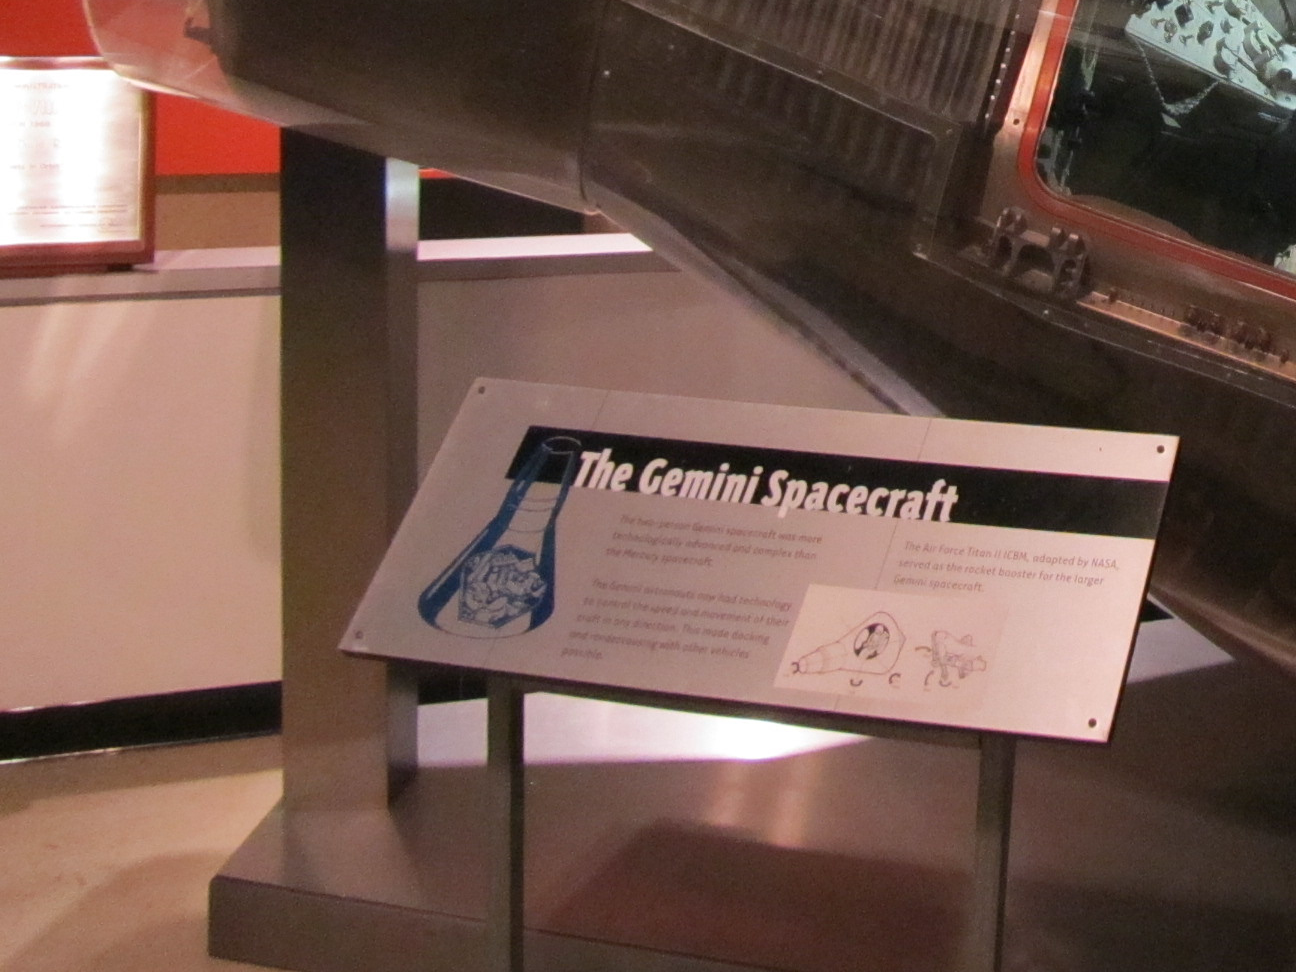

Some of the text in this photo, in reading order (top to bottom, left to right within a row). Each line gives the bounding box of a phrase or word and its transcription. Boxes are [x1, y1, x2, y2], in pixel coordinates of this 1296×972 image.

[574, 447, 960, 522] The Gemini Spacecraft
[692, 522, 724, 533] Gemini
[727, 528, 776, 540] spacecraft
[778, 533, 796, 541] was
[798, 535, 822, 544] more
[612, 532, 817, 559] technologically advanced and complex than
[905, 540, 921, 552] The
[922, 542, 937, 554] Air
[938, 543, 965, 556] Force
[968, 546, 992, 558] Titan
[1003, 550, 1029, 563] ICBM,
[1032, 554, 1075, 566] adapted
[1076, 556, 1089, 568] by
[1091, 558, 1120, 571] NASA,
[605, 548, 623, 557] the
[623, 549, 658, 564] Mercury
[893, 573, 985, 593] Gemini spacecraft.
[898, 560, 931, 570] served
[946, 562, 963, 572] the
[964, 565, 996, 576] rocket
[998, 567, 1036, 579] booster
[1038, 570, 1053, 581] for
[1055, 572, 1072, 582] the
[1074, 574, 1104, 587] larger
[717, 593, 738, 604] had
[739, 595, 793, 612] technology
[700, 611, 752, 623] movement
[753, 615, 765, 623] of
[766, 616, 790, 627] their
[731, 631, 770, 645] docking
[710, 646, 750, 659] vehicles
